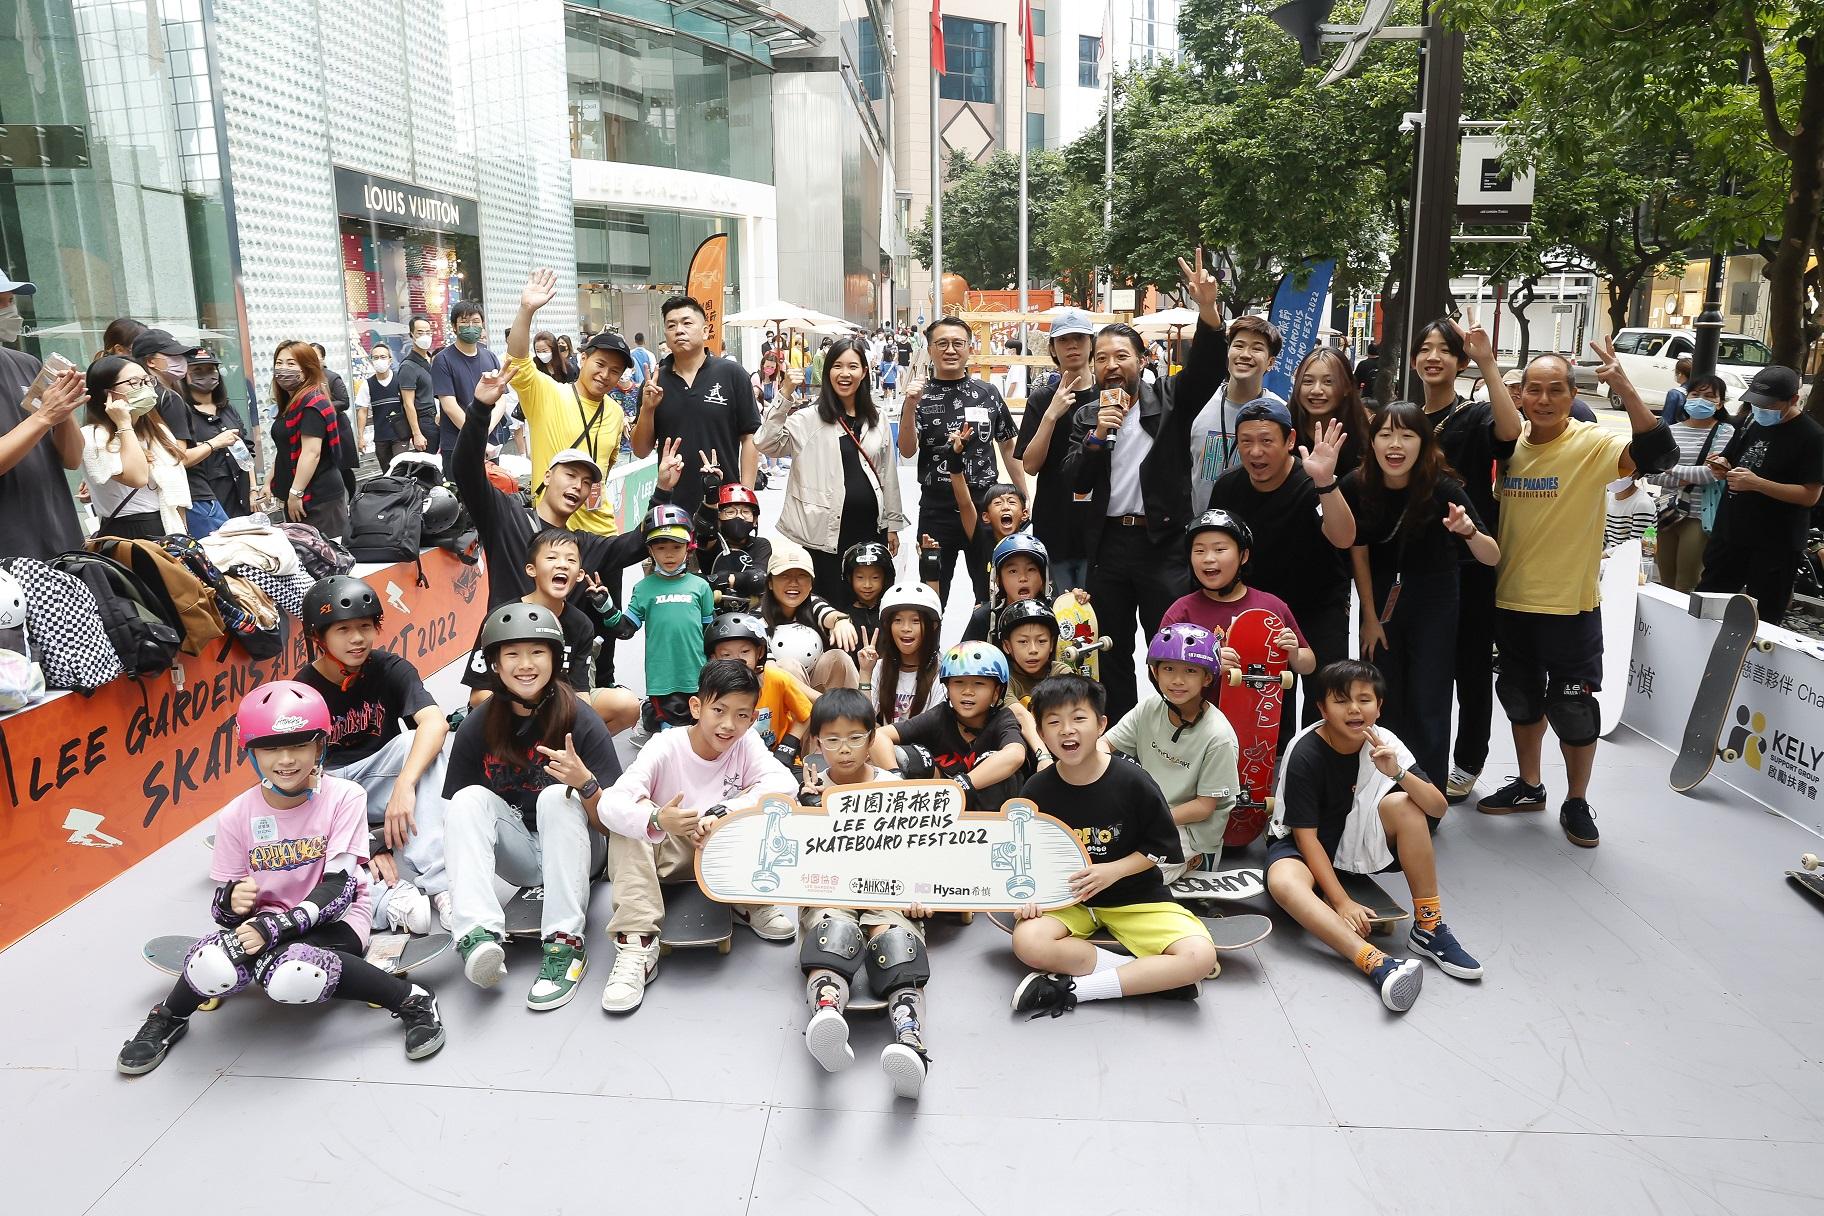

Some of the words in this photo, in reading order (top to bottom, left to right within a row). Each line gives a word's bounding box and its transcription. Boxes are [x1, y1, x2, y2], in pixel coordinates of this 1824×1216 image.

[364, 184, 406, 215] LOUIS
[409, 194, 460, 226] VUITTON
[1308, 291, 1320, 312] 2022
[1288, 309, 1304, 355] GARDENS
[1302, 313, 1315, 339] FEST
[1284, 357, 1294, 377] LEE
[417, 611, 457, 657] 2022
[1638, 618, 1653, 636] by:
[30, 725, 107, 802] LEE
[125, 661, 264, 756] GARDENS
[1772, 729, 1824, 771] KELY
[143, 714, 249, 829] SKAT
[1770, 755, 1798, 773] SUPPORT
[1798, 768, 1820, 783] GROUP
[839, 789, 951, 814] 利園滑板節
[832, 818, 866, 833] LEE
[873, 813, 954, 832] GARDENS
[805, 834, 903, 855] SKATEBOARD
[863, 879, 890, 894] AHKSA
[933, 884, 970, 897] Hysan
